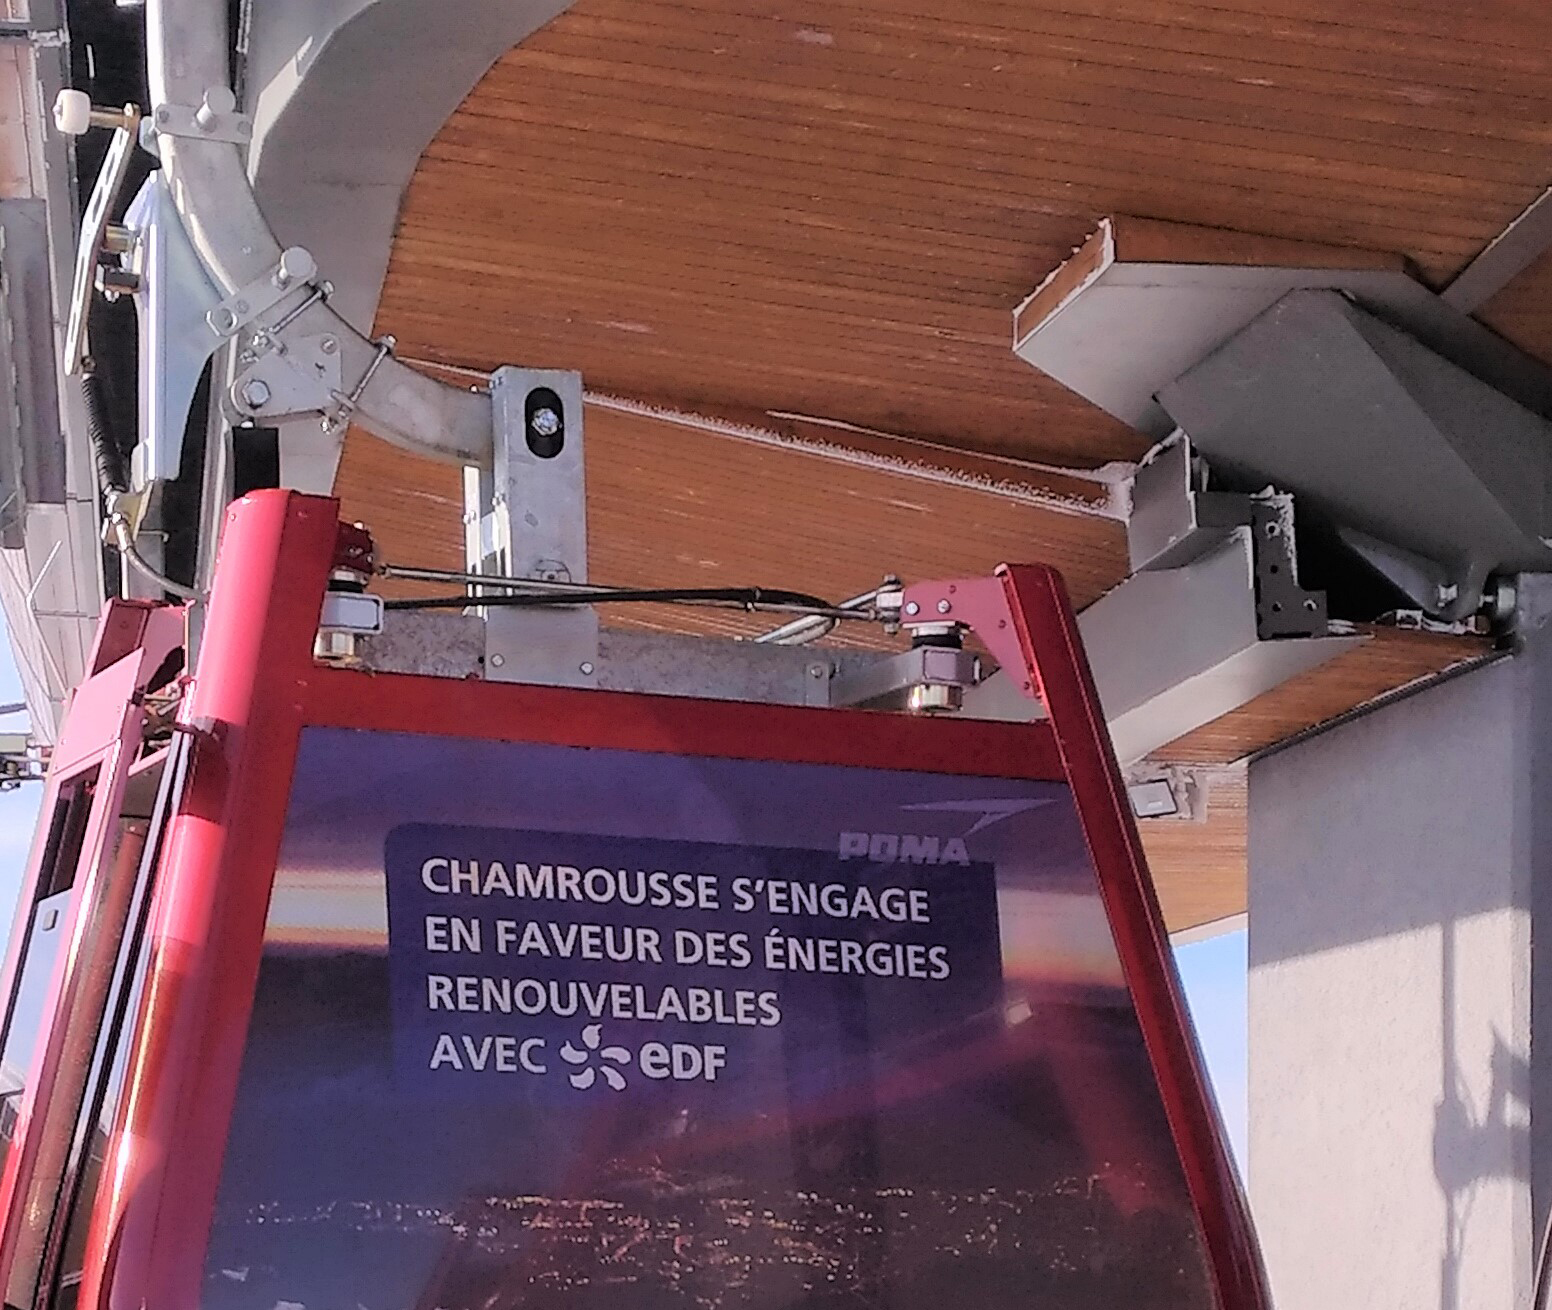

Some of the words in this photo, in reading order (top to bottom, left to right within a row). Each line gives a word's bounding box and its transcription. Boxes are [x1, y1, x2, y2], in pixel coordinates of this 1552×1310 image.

[838, 831, 970, 867] POMA
[421, 858, 720, 910] CHAMROUSSE
[732, 876, 931, 924] S'ENGAGE
[425, 916, 481, 954] EN
[496, 920, 662, 963] FAVEUR
[675, 930, 751, 969] DES
[765, 928, 950, 980] ÉNERGIES
[427, 975, 782, 1027] RENOUVELABLES
[429, 1034, 547, 1075] AVEC
